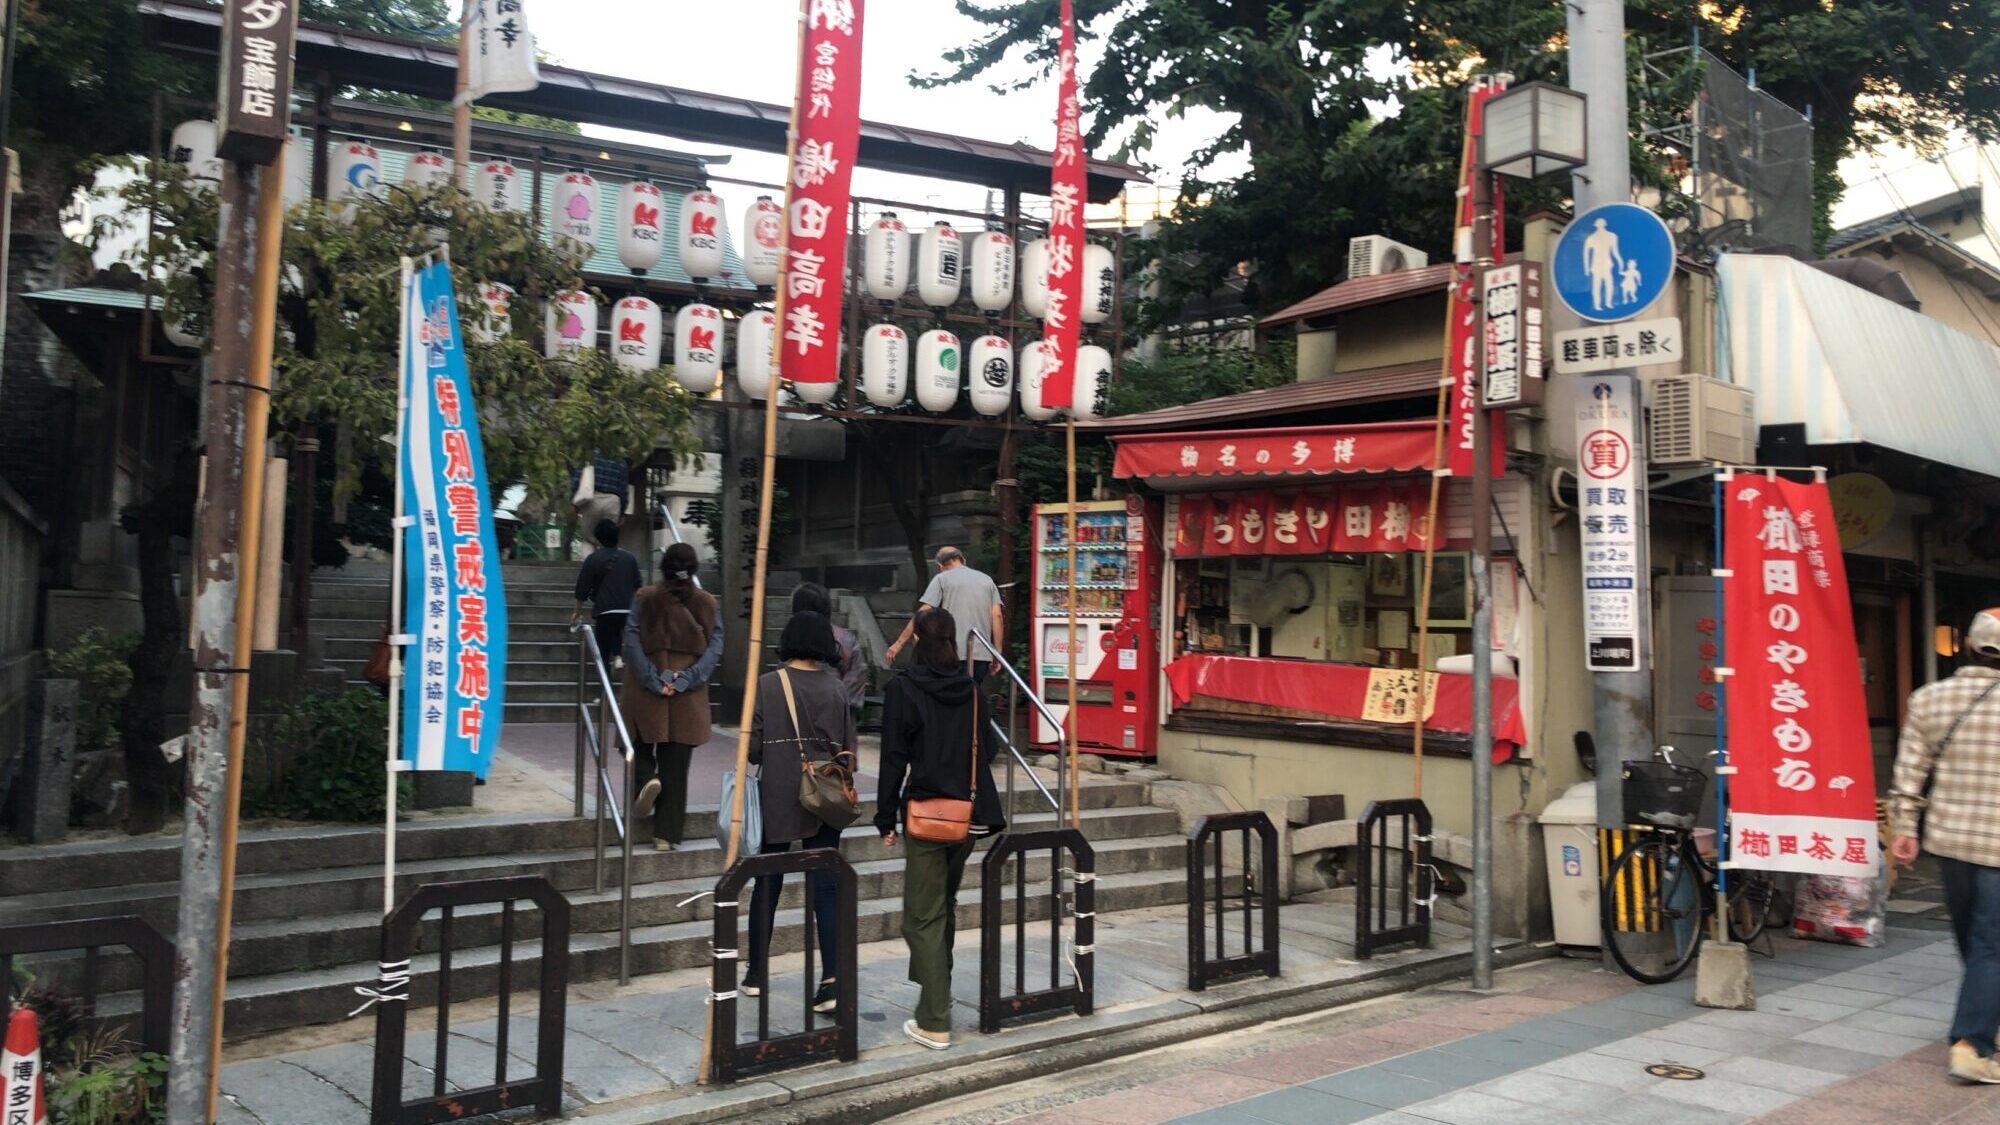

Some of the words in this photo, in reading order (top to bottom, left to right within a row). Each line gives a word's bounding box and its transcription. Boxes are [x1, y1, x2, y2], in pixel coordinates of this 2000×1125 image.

[240, 36, 278, 118] 宝飾店
[631, 227, 659, 242] KBC
[689, 236, 716, 250] KBC
[620, 344, 648, 356] KBC
[688, 351, 716, 364] KBC
[1563, 330, 1672, 363] 軽車両を除く
[1589, 439, 1620, 470] 質
[1585, 487, 1627, 507] 買取
[1584, 514, 1628, 534] 販売
[434, 374, 490, 753] 特別警戒実施中
[1755, 505, 1817, 792] 櫛田のやきもち
[1738, 828, 1870, 865] 櫛田茶屋
[9, 1061, 35, 1125] 博多区
